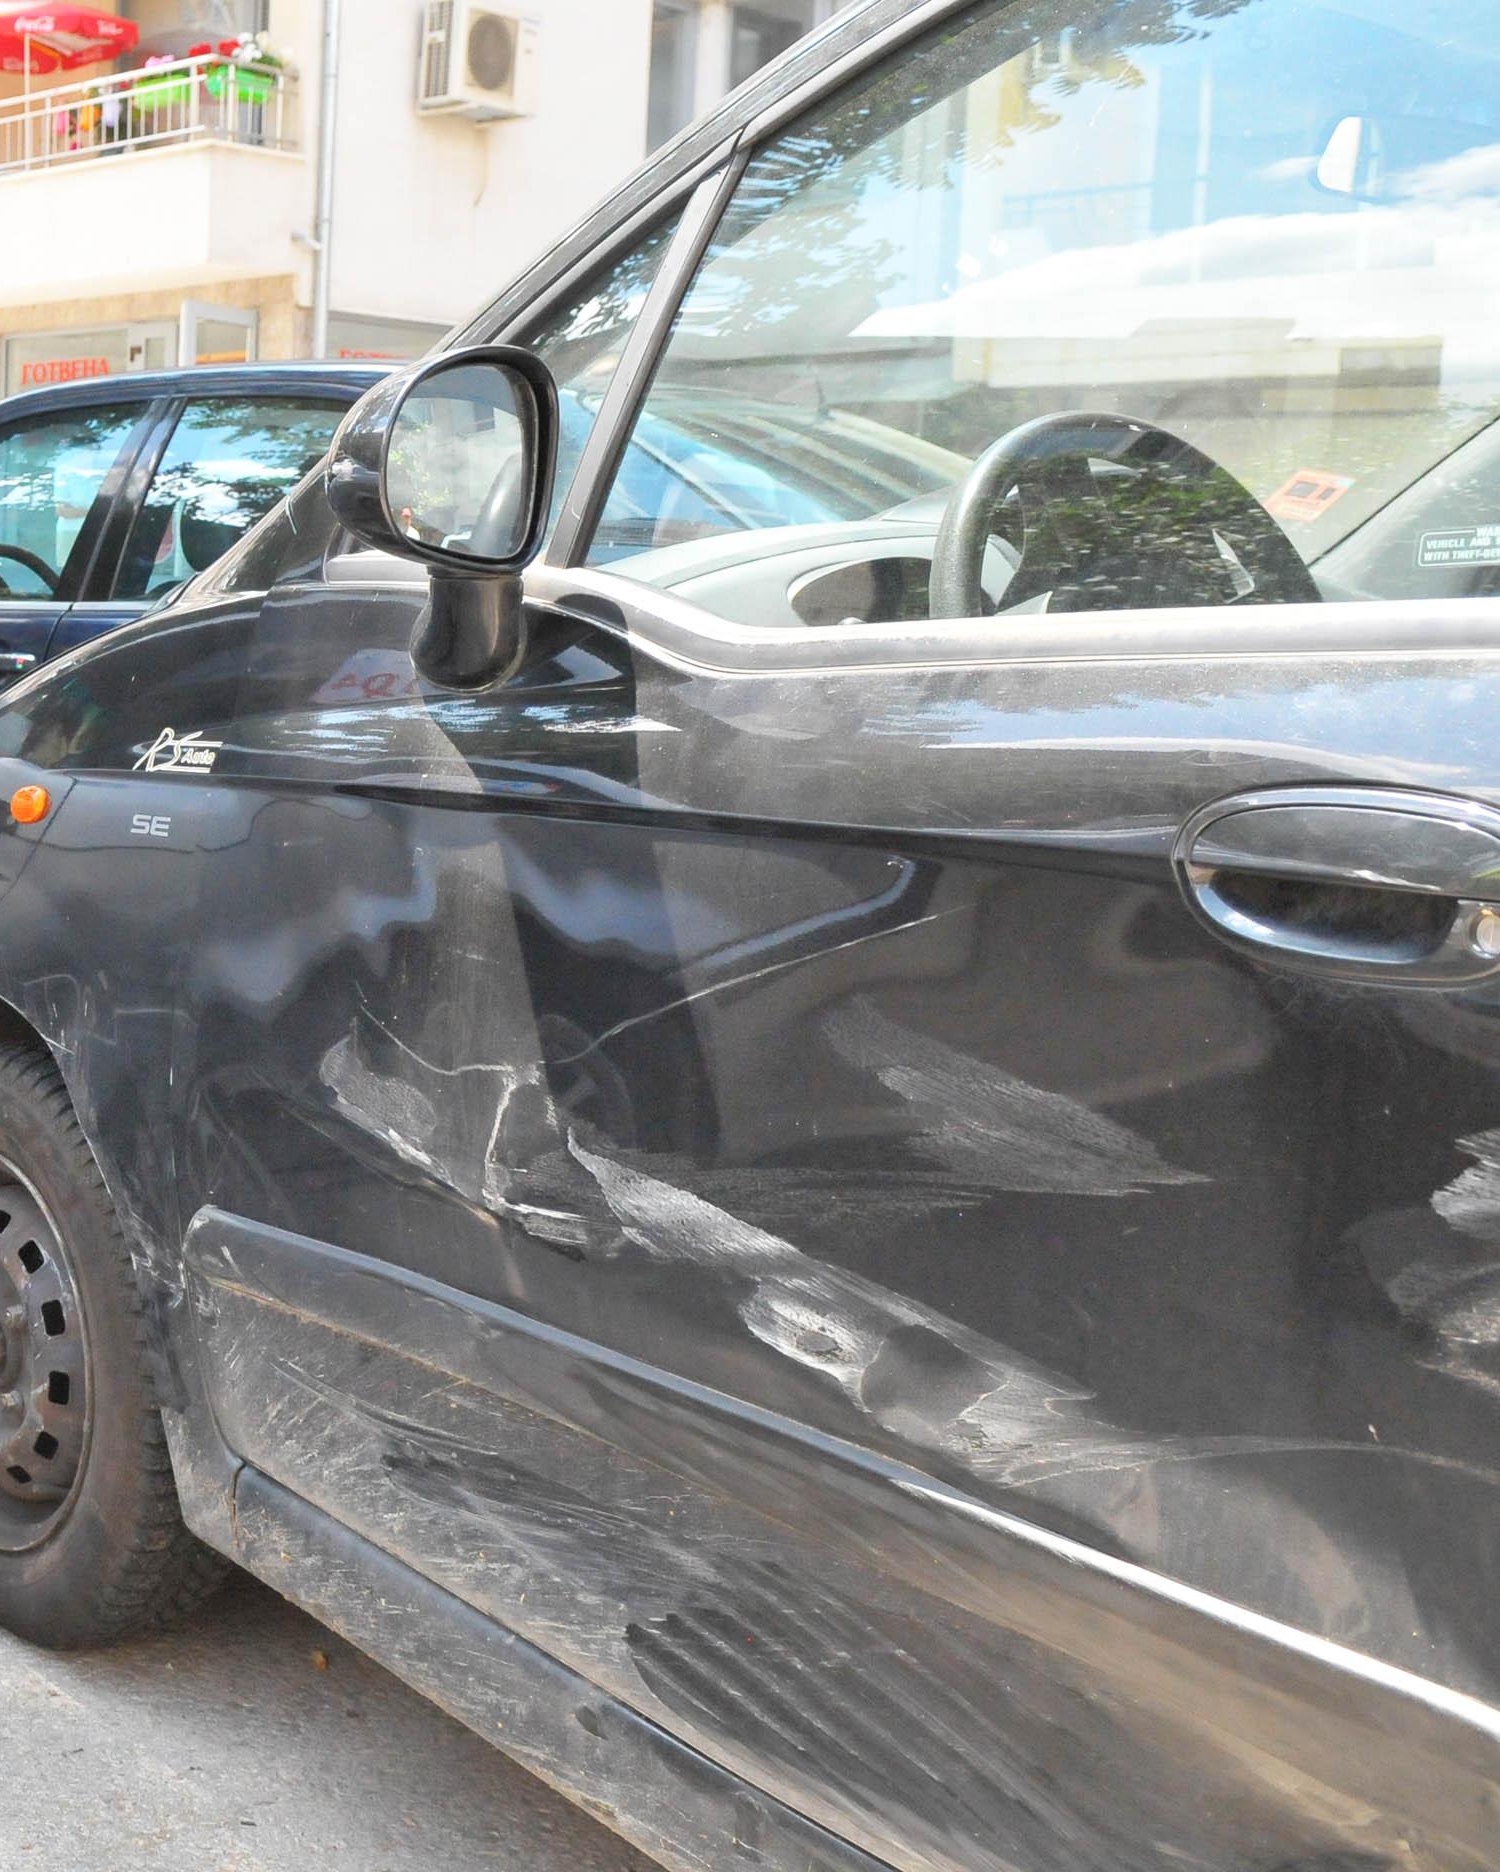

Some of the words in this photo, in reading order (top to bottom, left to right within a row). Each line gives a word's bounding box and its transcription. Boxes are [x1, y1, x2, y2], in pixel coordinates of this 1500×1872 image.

[21, 356, 111, 385] ГОТВЕНА
[1426, 537, 1466, 549] VEHICLE
[1423, 550, 1451, 561] WITH
[180, 748, 216, 765] Auto
[130, 814, 171, 837] SE
